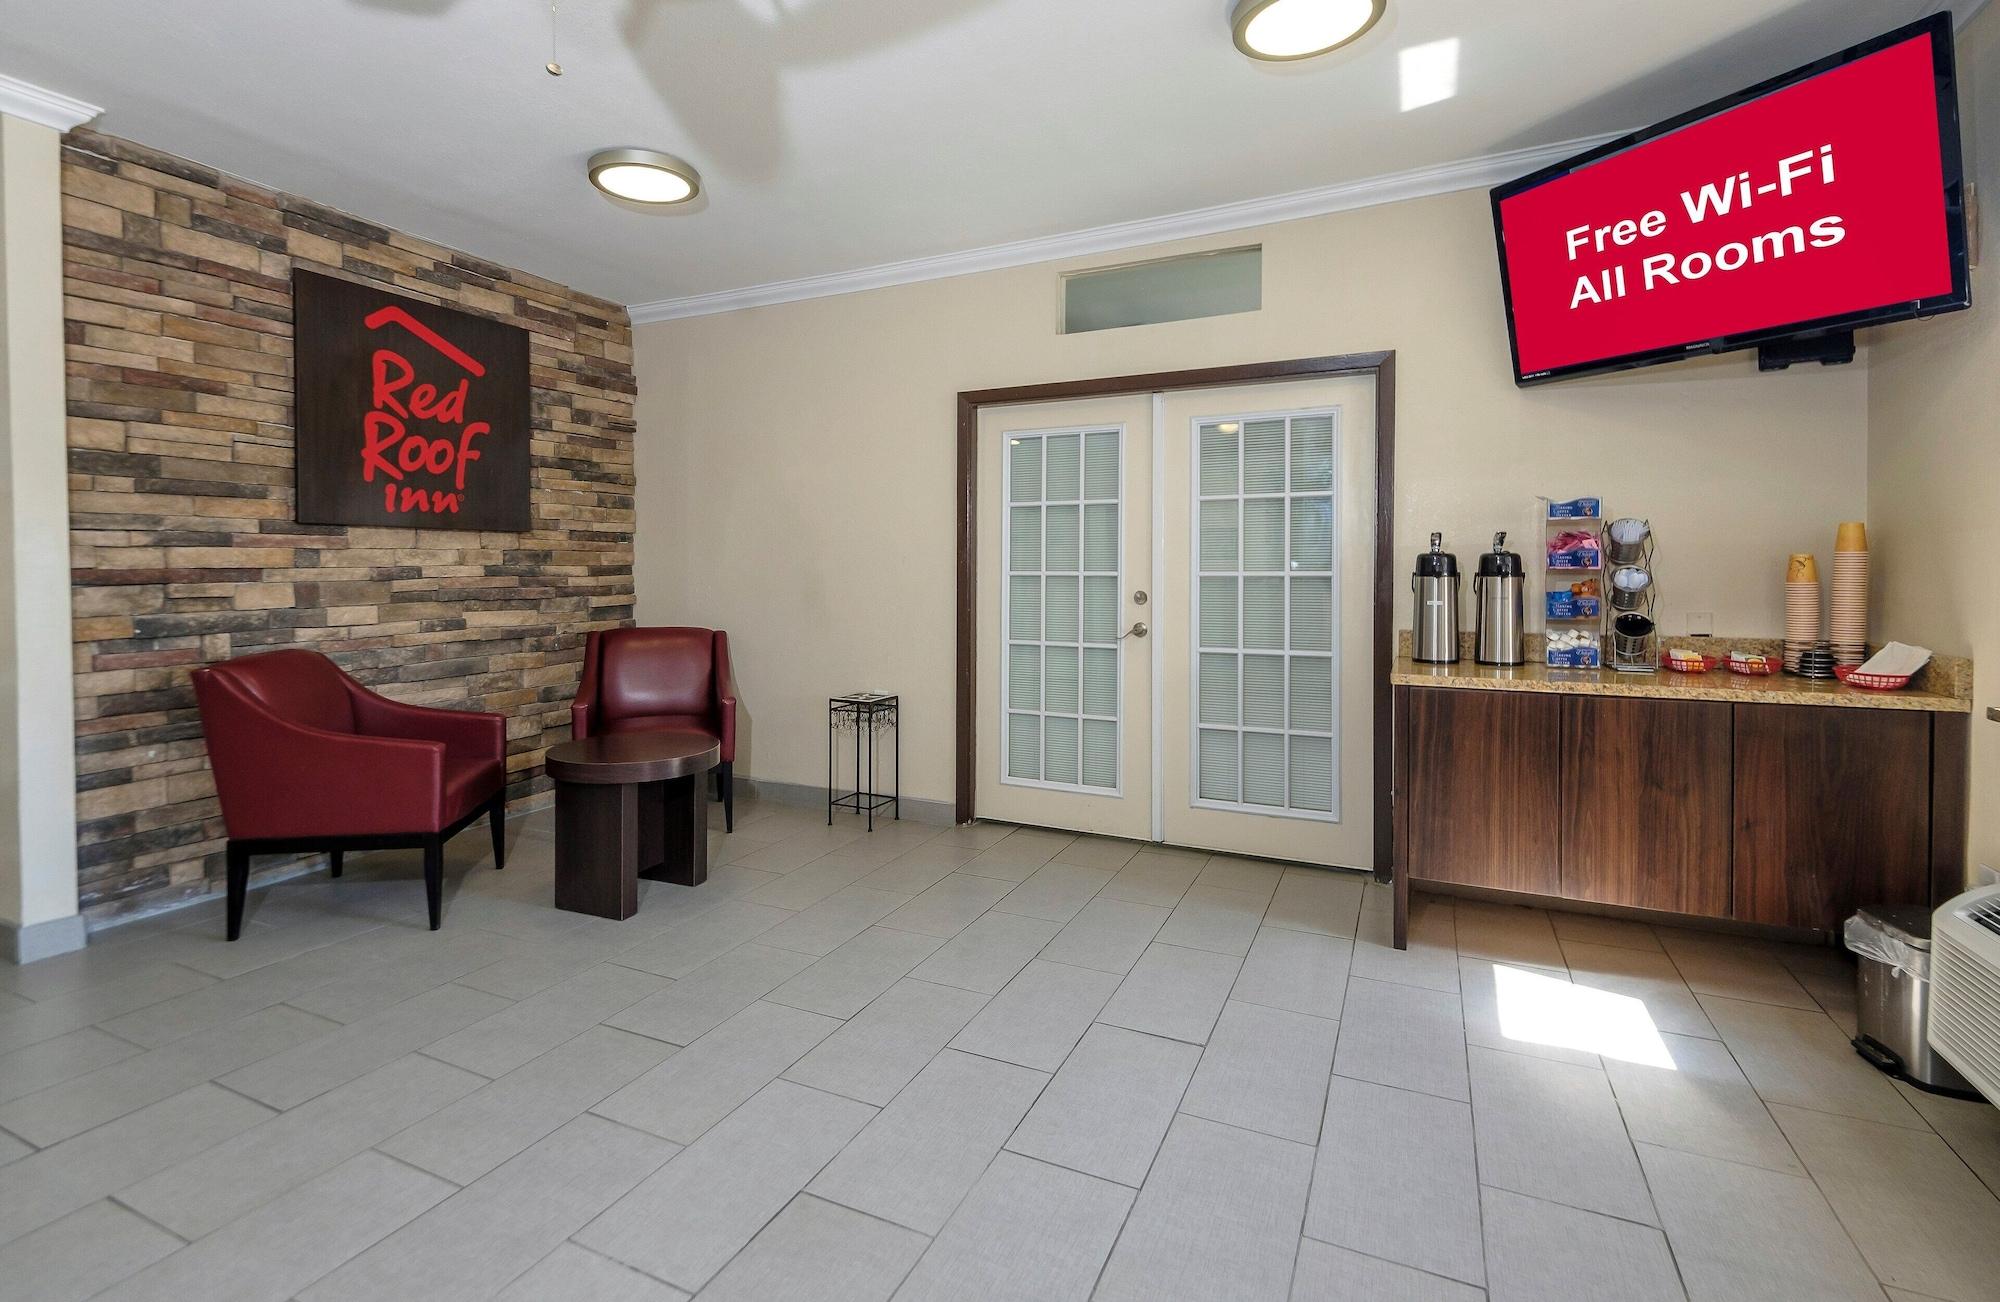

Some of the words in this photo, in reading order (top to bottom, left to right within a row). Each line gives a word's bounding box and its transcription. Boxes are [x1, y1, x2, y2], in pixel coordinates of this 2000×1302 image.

[1566, 210, 1667, 261] Free
[1680, 143, 1835, 224] Wi-Fi
[1570, 265, 1626, 310] All
[1642, 215, 1846, 291] Rooms
[372, 349, 469, 424] Red
[361, 410, 490, 490] Roof
